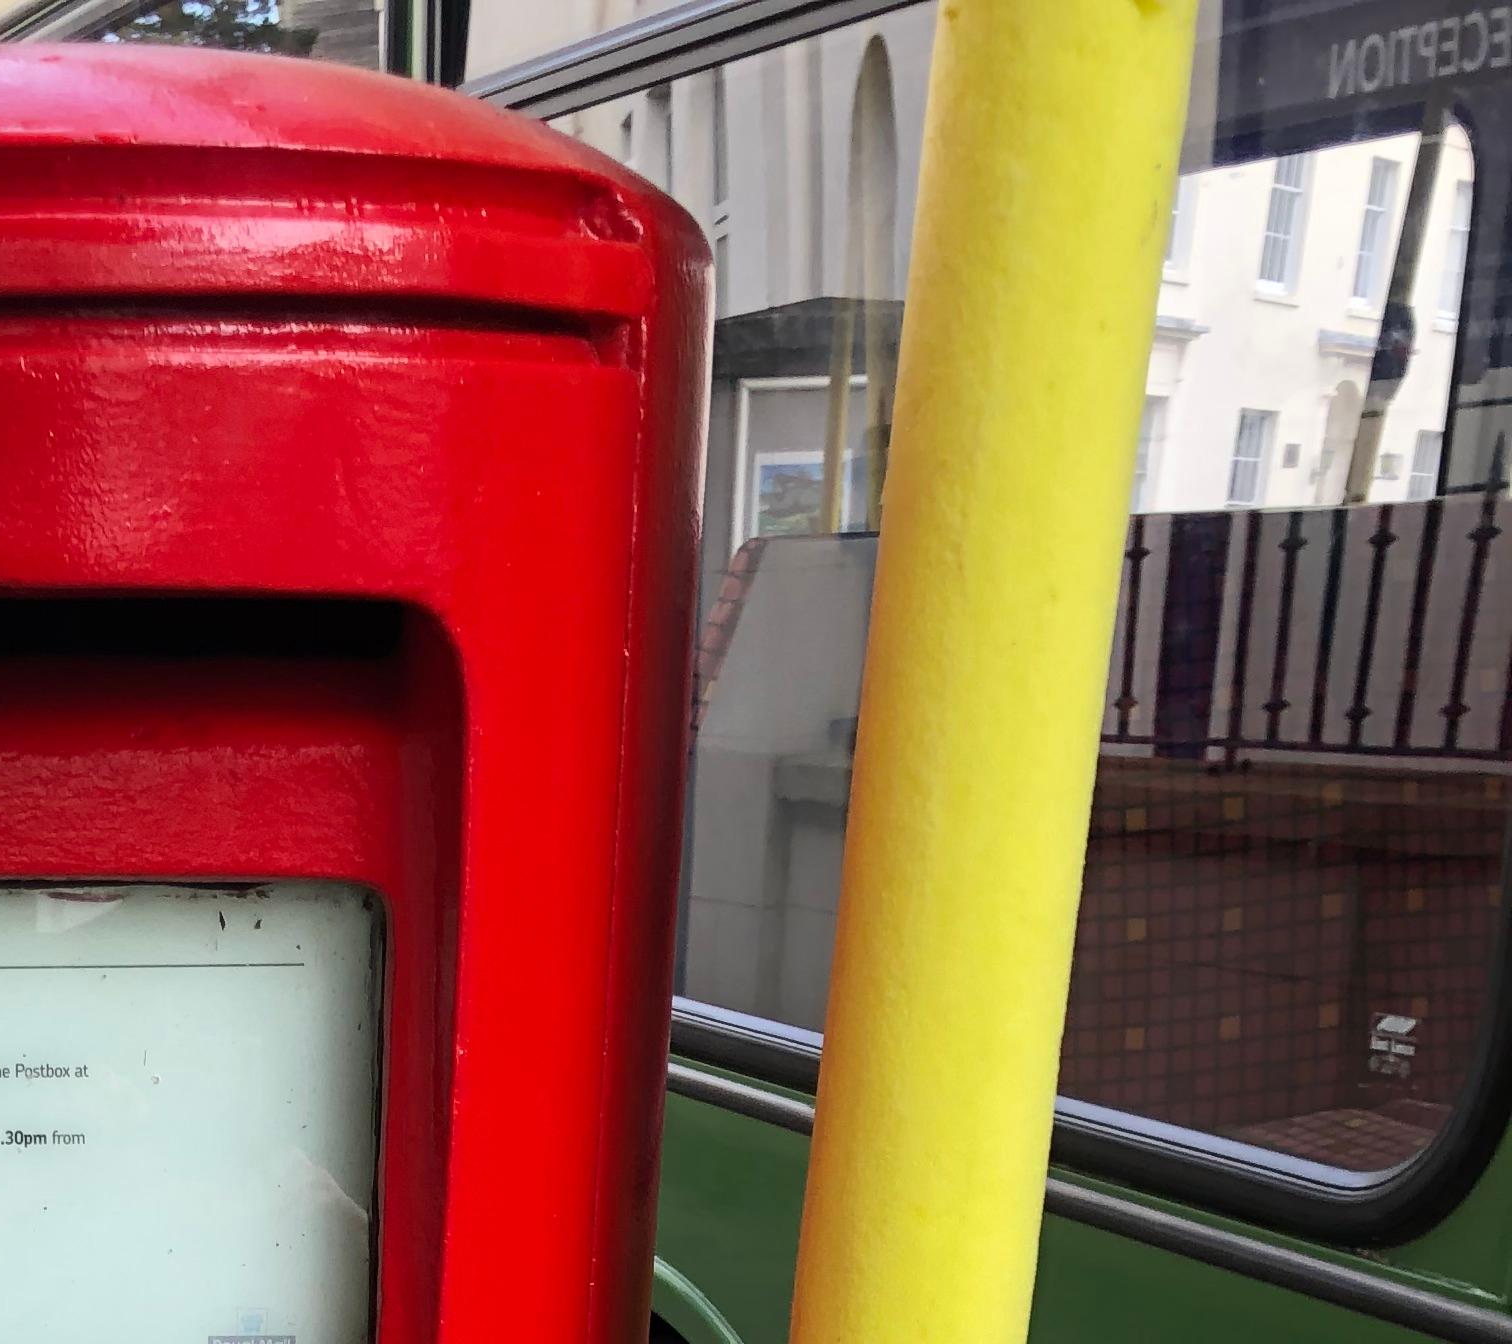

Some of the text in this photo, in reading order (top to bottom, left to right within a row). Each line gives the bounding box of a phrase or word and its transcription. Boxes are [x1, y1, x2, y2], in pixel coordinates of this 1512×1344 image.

[15, 1063, 70, 1079] Postbox
[75, 1064, 89, 1078] at
[52, 1130, 86, 1145] from
